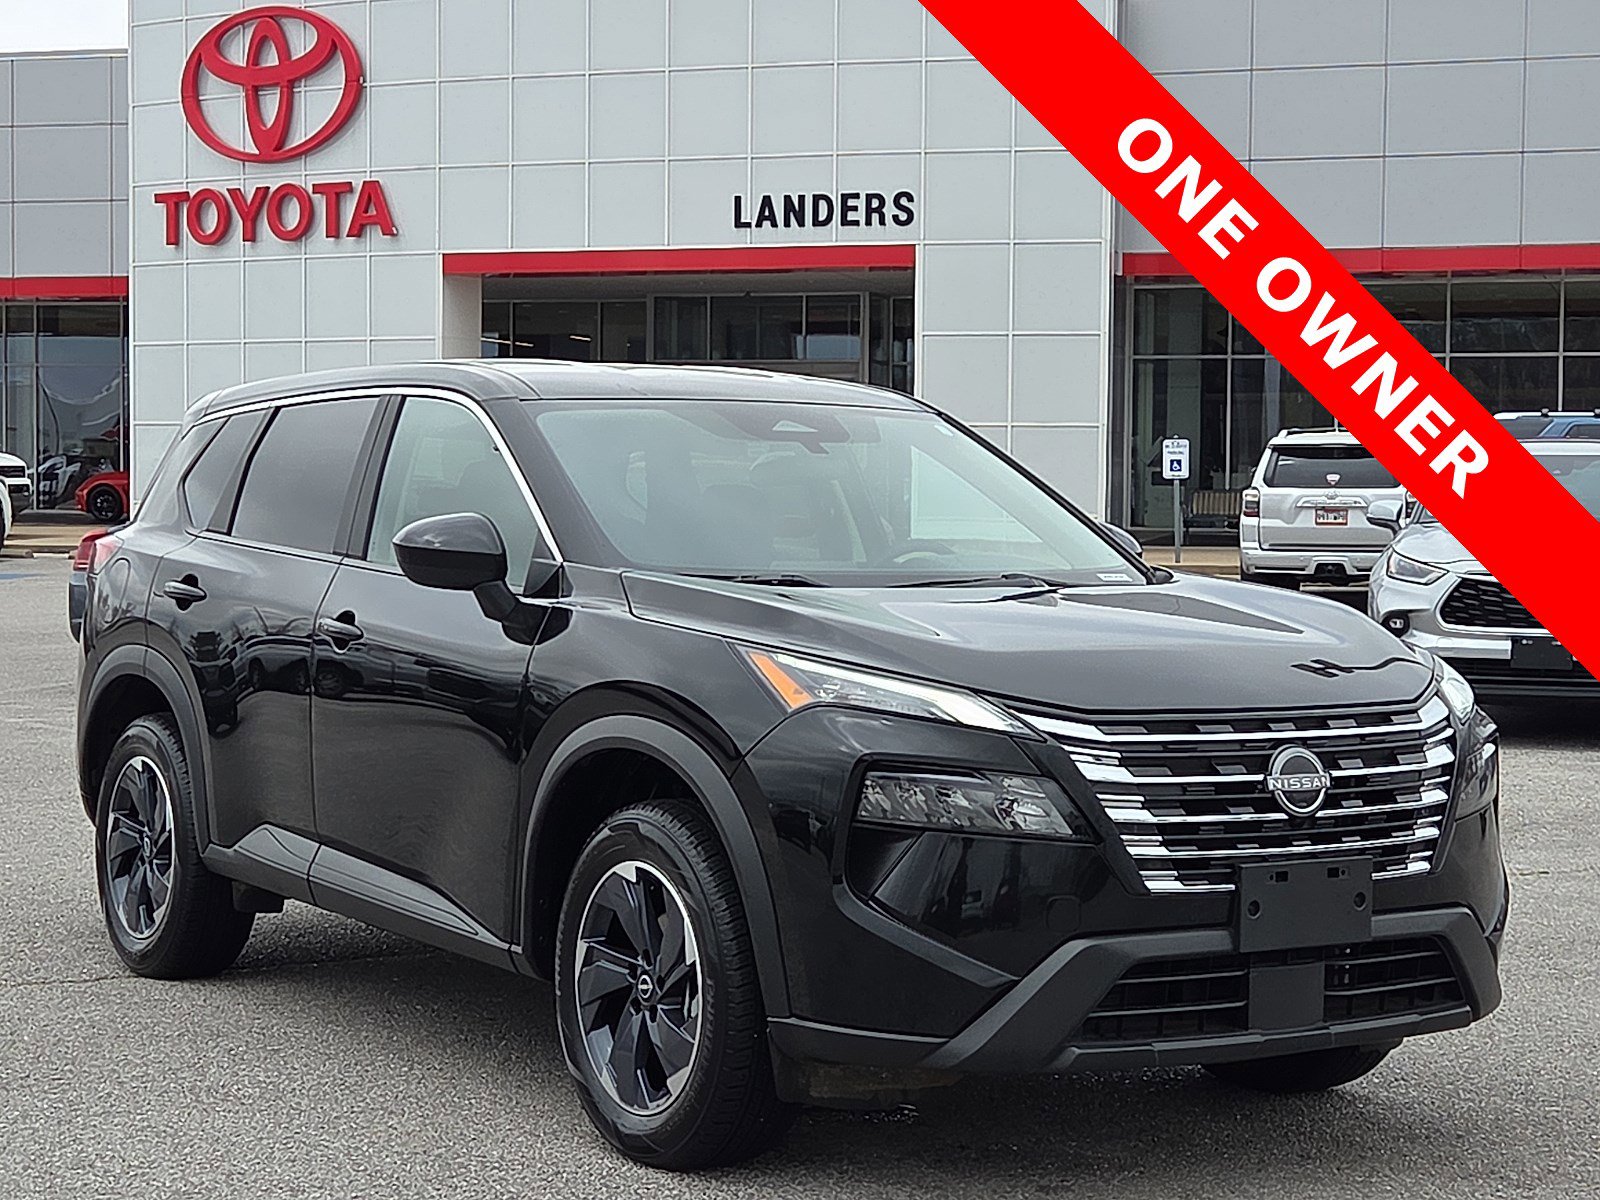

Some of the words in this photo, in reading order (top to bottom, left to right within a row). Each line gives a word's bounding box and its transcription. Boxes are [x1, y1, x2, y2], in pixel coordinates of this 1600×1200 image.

[154, 180, 397, 246] TOYOTA
[734, 191, 915, 229] LANDERS
[1269, 775, 1329, 790] NISSAN
